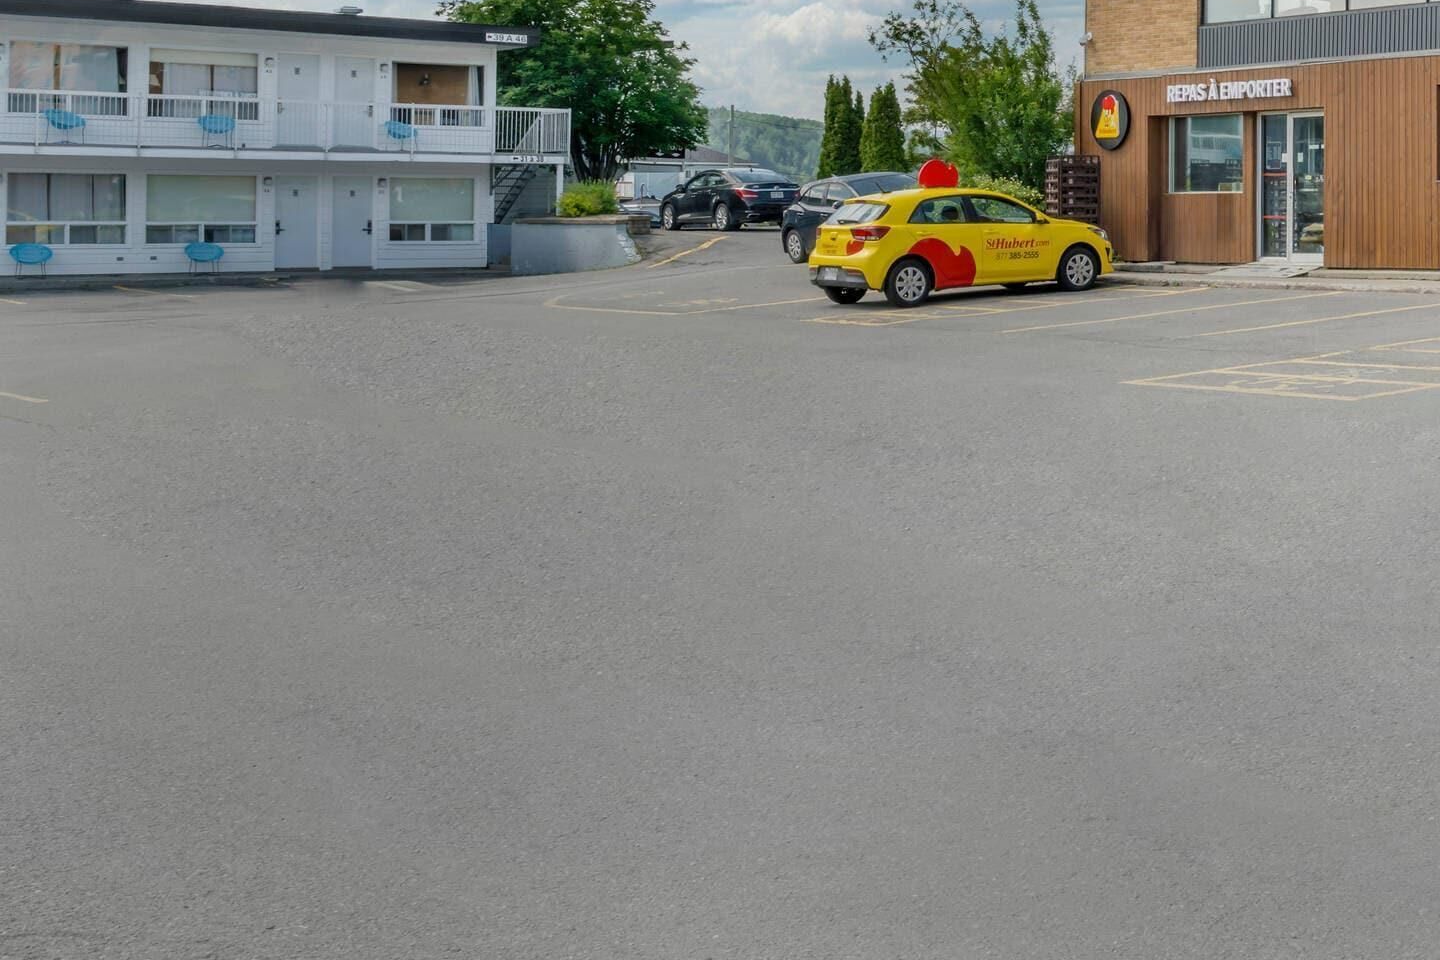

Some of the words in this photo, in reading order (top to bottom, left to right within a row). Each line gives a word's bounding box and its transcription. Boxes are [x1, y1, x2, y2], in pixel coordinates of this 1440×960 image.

[1167, 83, 1208, 102] REPAS
[1208, 78, 1219, 100] À
[1220, 79, 1292, 100] EMPORTER
